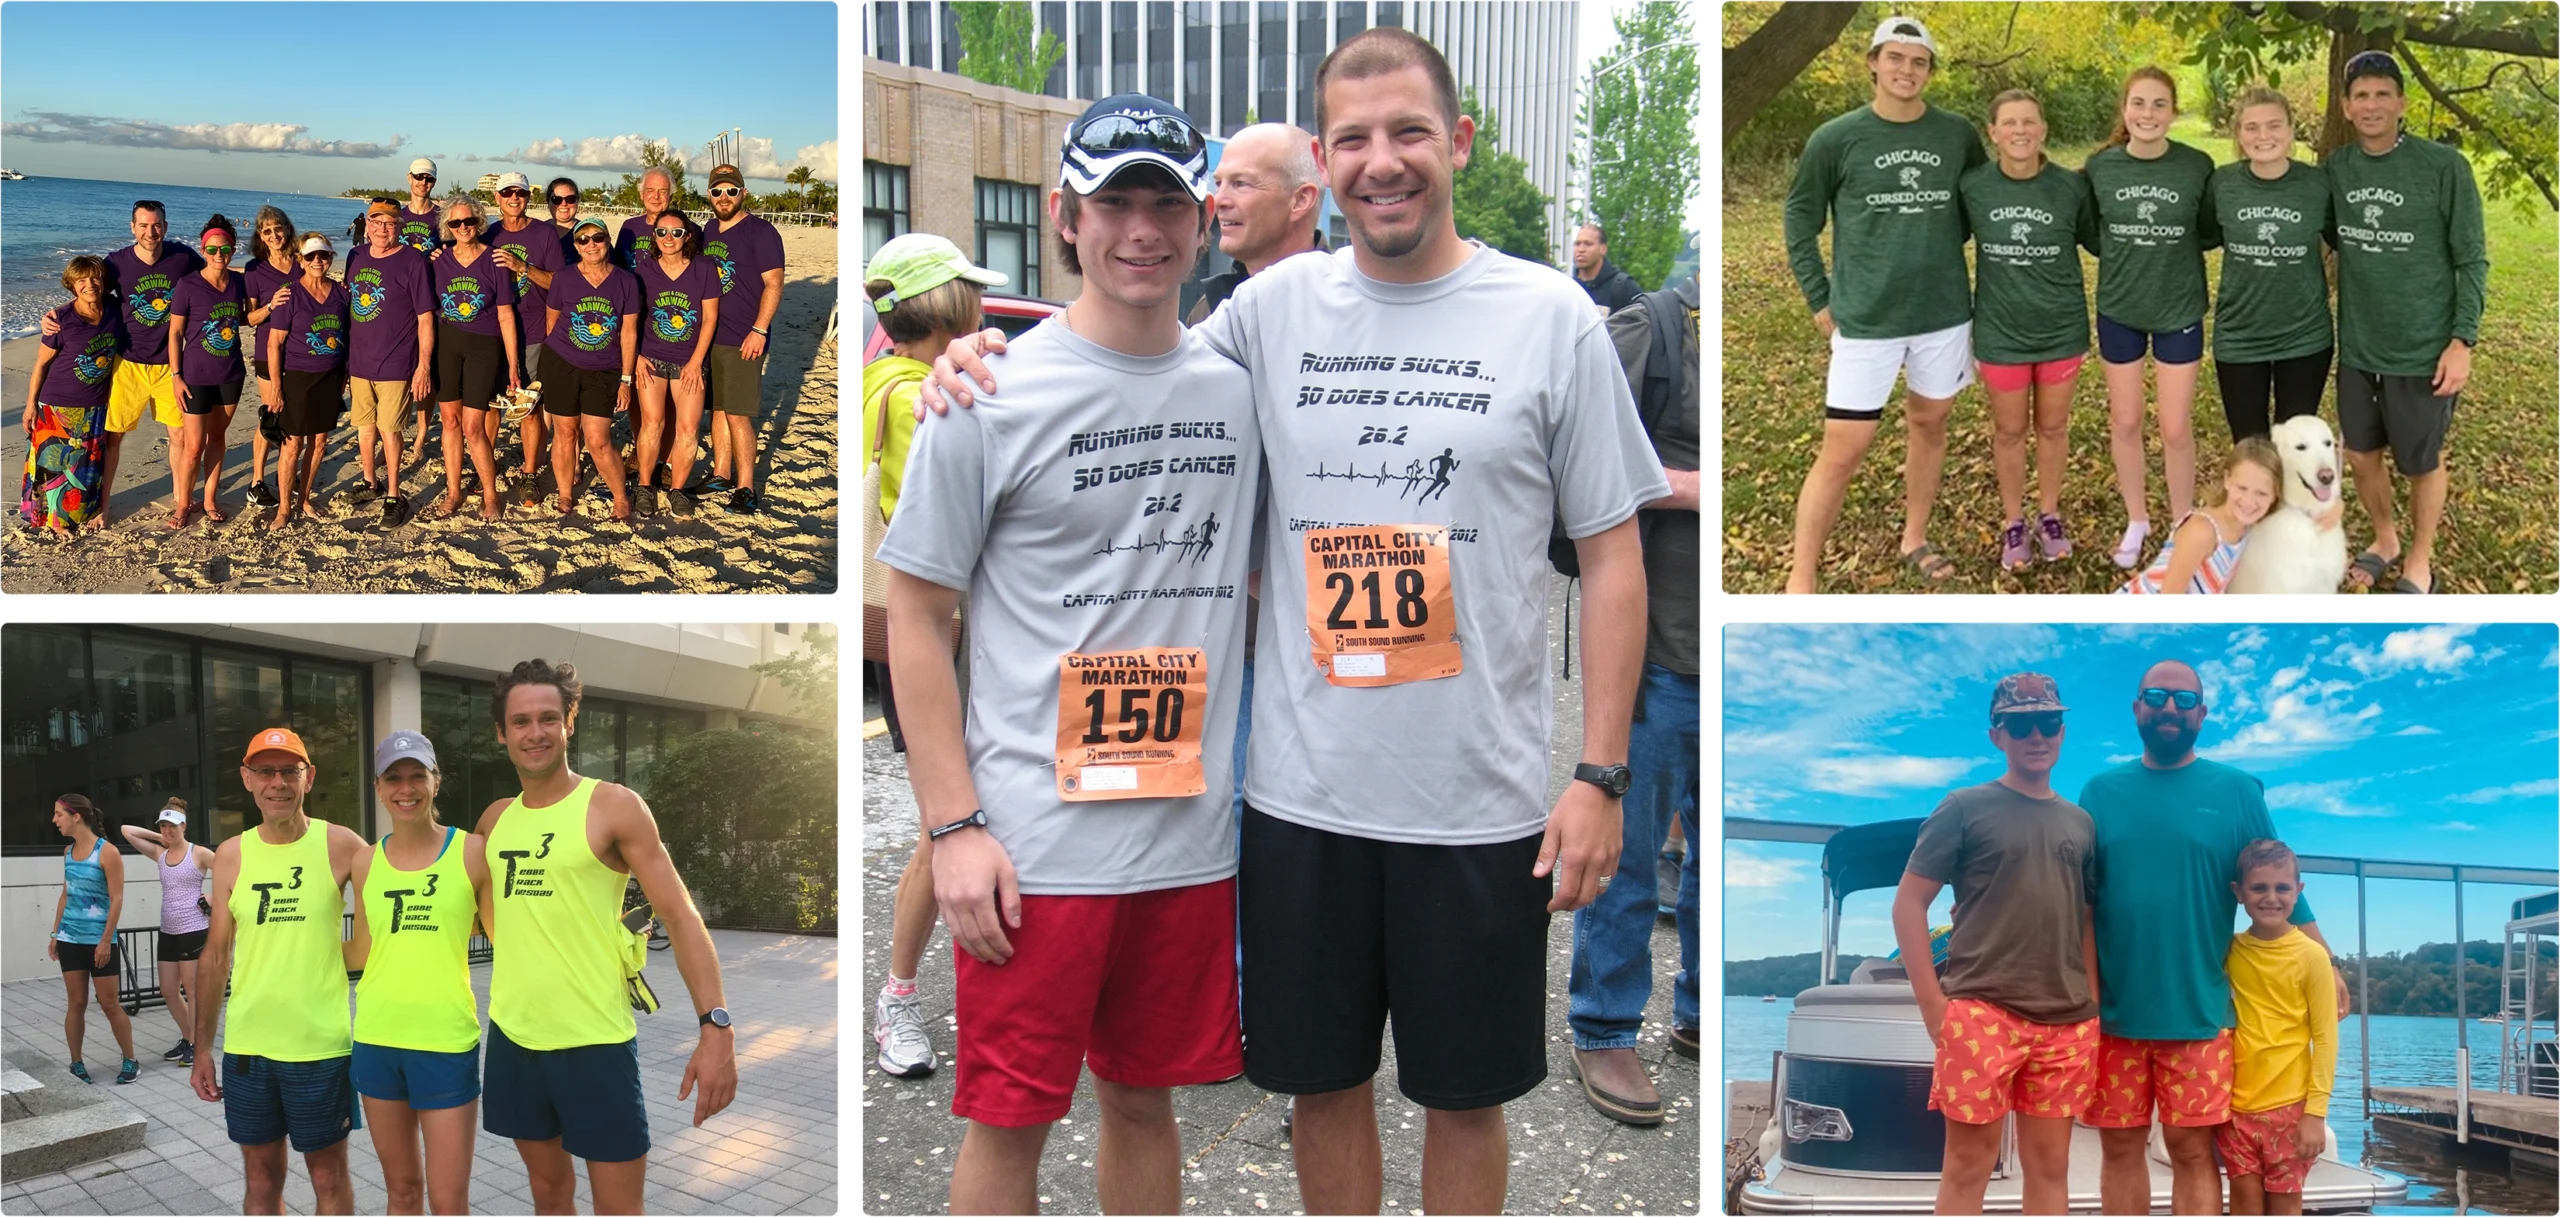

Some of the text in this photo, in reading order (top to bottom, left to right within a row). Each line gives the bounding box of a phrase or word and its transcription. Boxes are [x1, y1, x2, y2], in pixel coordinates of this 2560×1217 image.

[1874, 150, 1941, 169] CHICAGO
[1866, 190, 1951, 205] CURSED COVID
[2115, 185, 2179, 204] CHICAGO
[2346, 187, 2404, 207] CHCAGO
[1989, 206, 2053, 225] CHICAGO
[2237, 206, 2302, 223] CHICAGO
[402, 226, 432, 237] NARWHAL
[2109, 223, 2185, 236] CURSED COVID
[2376, 231, 2415, 243] COVID
[703, 246, 730, 260] NARWHAL
[2025, 245, 2061, 256] COVID
[2228, 242, 2308, 257] CURSED COVID
[134, 279, 172, 294] NARWHAL
[354, 272, 383, 287] NARWHAL
[446, 281, 481, 294] NARWHAL
[576, 301, 614, 316] NARWHAL
[655, 296, 692, 310] NARWHAL
[595, 336, 613, 351] SOCIETY
[1300, 352, 1496, 382] RUNNING SUCKS...
[1296, 386, 1492, 415] SO DOES CANCER
[1068, 421, 1237, 457] RUNNING SUCKS...
[1358, 425, 1409, 446] 26.2
[1073, 454, 1236, 492] SO DOES CANCER
[1143, 492, 1182, 517] 26.2
[1310, 532, 1438, 553] CAPITAL CITY
[1449, 528, 1478, 543] 2012
[1322, 550, 1426, 569] MARATHON
[1119, 589, 1149, 601] CITY
[1149, 586, 1215, 599] MARATHON
[1325, 568, 1429, 630] 218
[1345, 633, 1426, 647] SOUTH SOUND RUNNING
[1067, 653, 1197, 669] CAPITAL CITY
[1081, 670, 1187, 685] MARATHON
[1082, 689, 1185, 744] 150
[1097, 749, 1175, 760] SOUTH SOUND RUNNING
